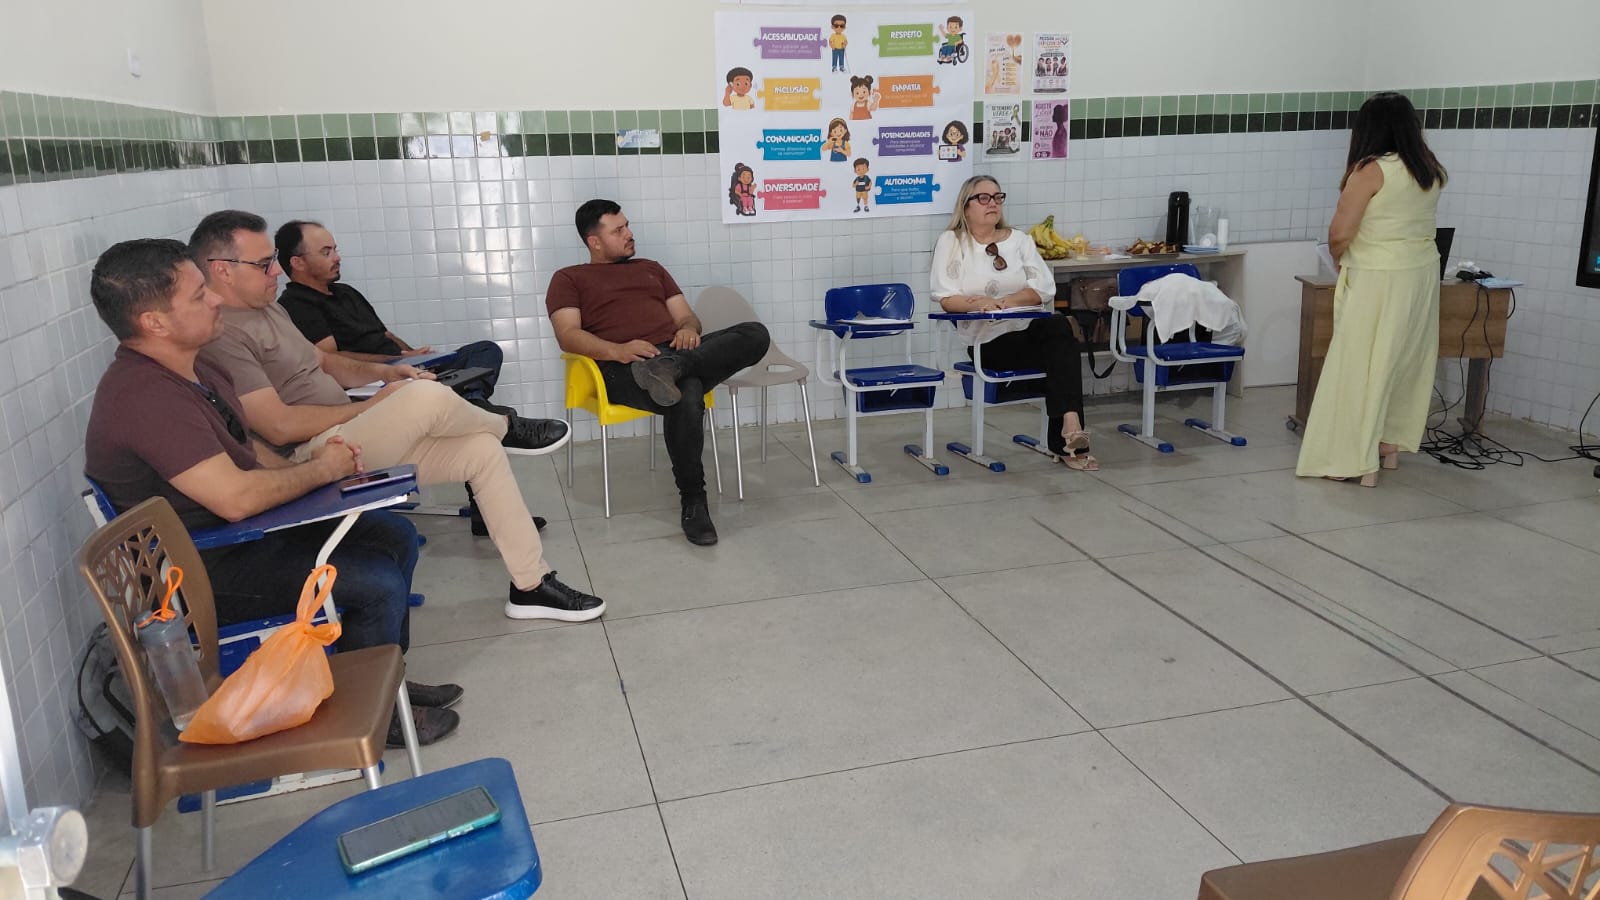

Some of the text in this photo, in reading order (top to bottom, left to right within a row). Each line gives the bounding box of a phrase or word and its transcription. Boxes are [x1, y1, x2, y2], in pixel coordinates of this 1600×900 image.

[762, 33, 819, 41] ACESSIBILIDADE
[890, 30, 923, 39] RESPEITO
[774, 84, 809, 94] INCLUSÃO
[891, 83, 921, 92] EMPATIA
[765, 133, 820, 145] COMUNICAÇÃO
[880, 131, 931, 140] POTENCIALIDADES
[884, 176, 927, 186] AUTONOMIA
[764, 182, 819, 193] DIVERSIDADE
